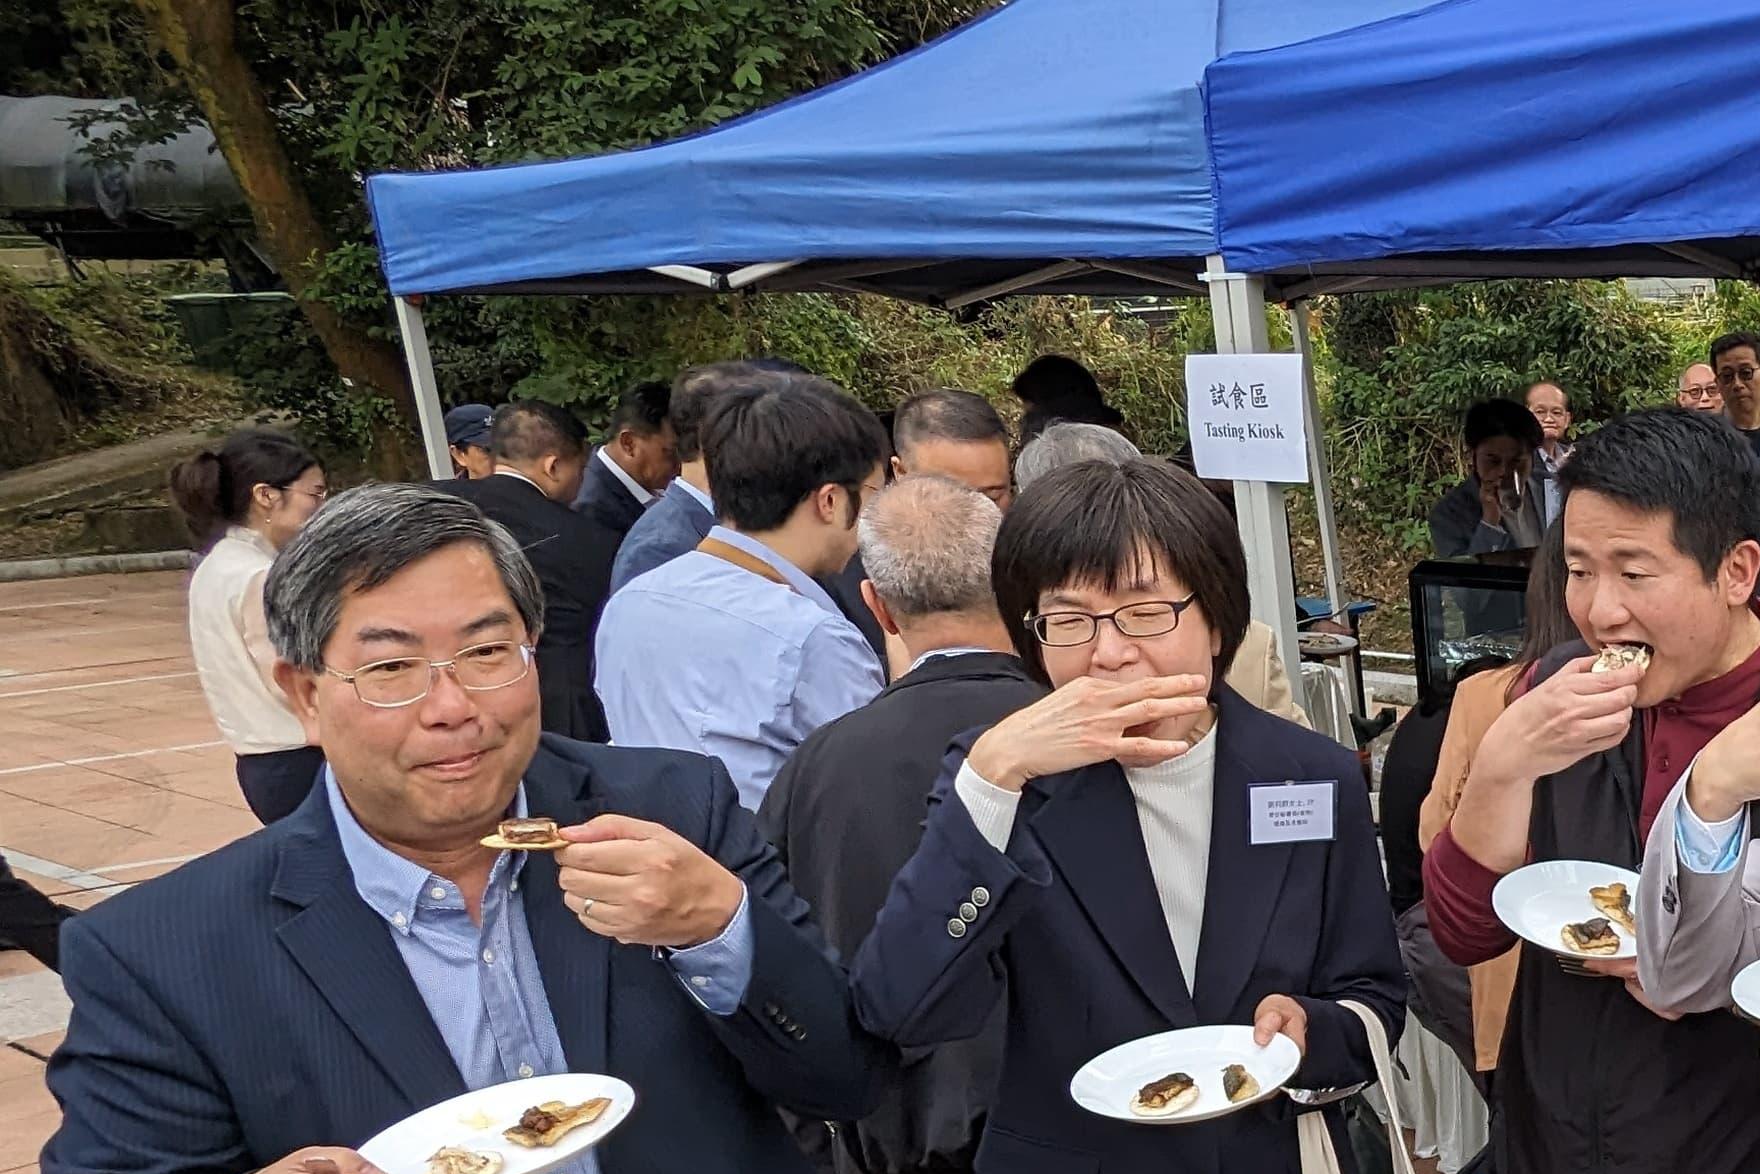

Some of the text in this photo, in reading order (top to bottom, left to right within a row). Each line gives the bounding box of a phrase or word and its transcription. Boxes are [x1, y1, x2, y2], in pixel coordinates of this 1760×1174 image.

[1209, 381, 1269, 411] 試食區
[1204, 422, 1285, 442] Tasting Kiosk
